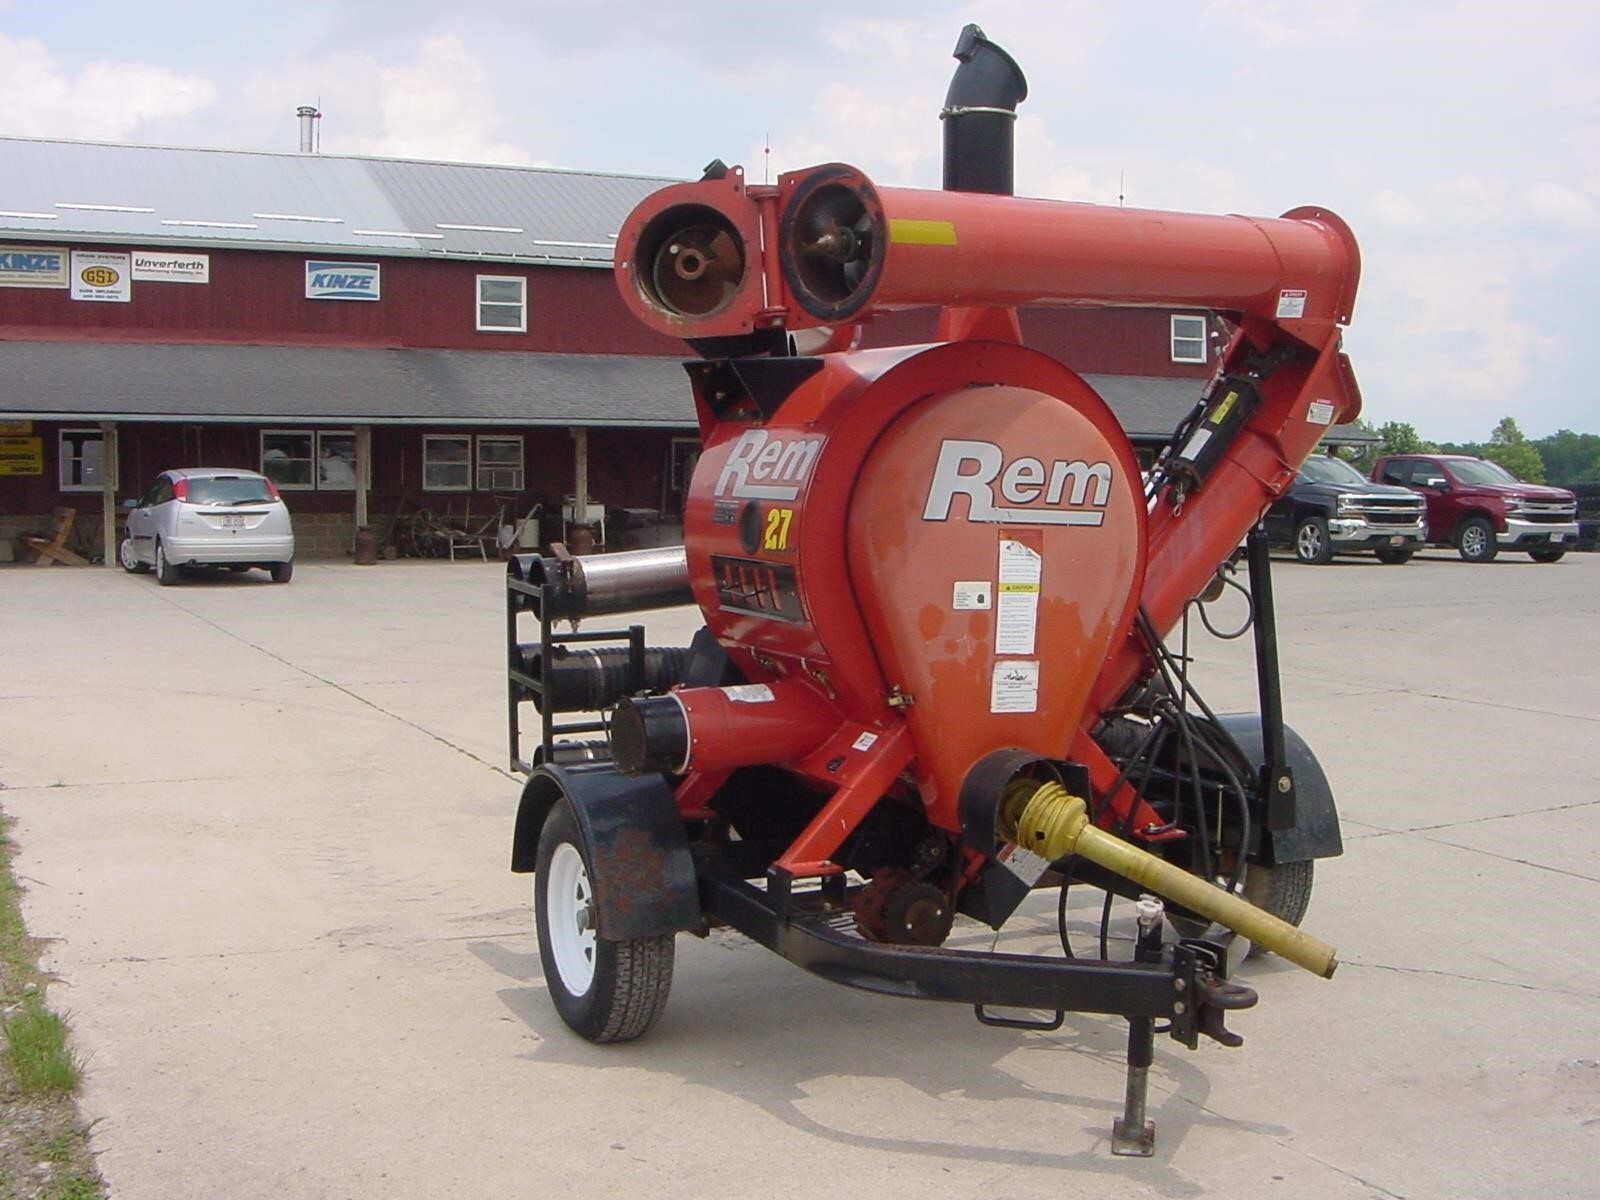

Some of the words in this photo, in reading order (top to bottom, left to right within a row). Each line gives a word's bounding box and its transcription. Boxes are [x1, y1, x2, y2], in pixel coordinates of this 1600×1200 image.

[86, 269, 114, 284] GSI
[135, 258, 204, 270] Unverferth
[311, 273, 374, 290] KINZE
[714, 429, 820, 499] Rem
[922, 439, 1112, 525] Rem
[764, 508, 793, 550] 27
